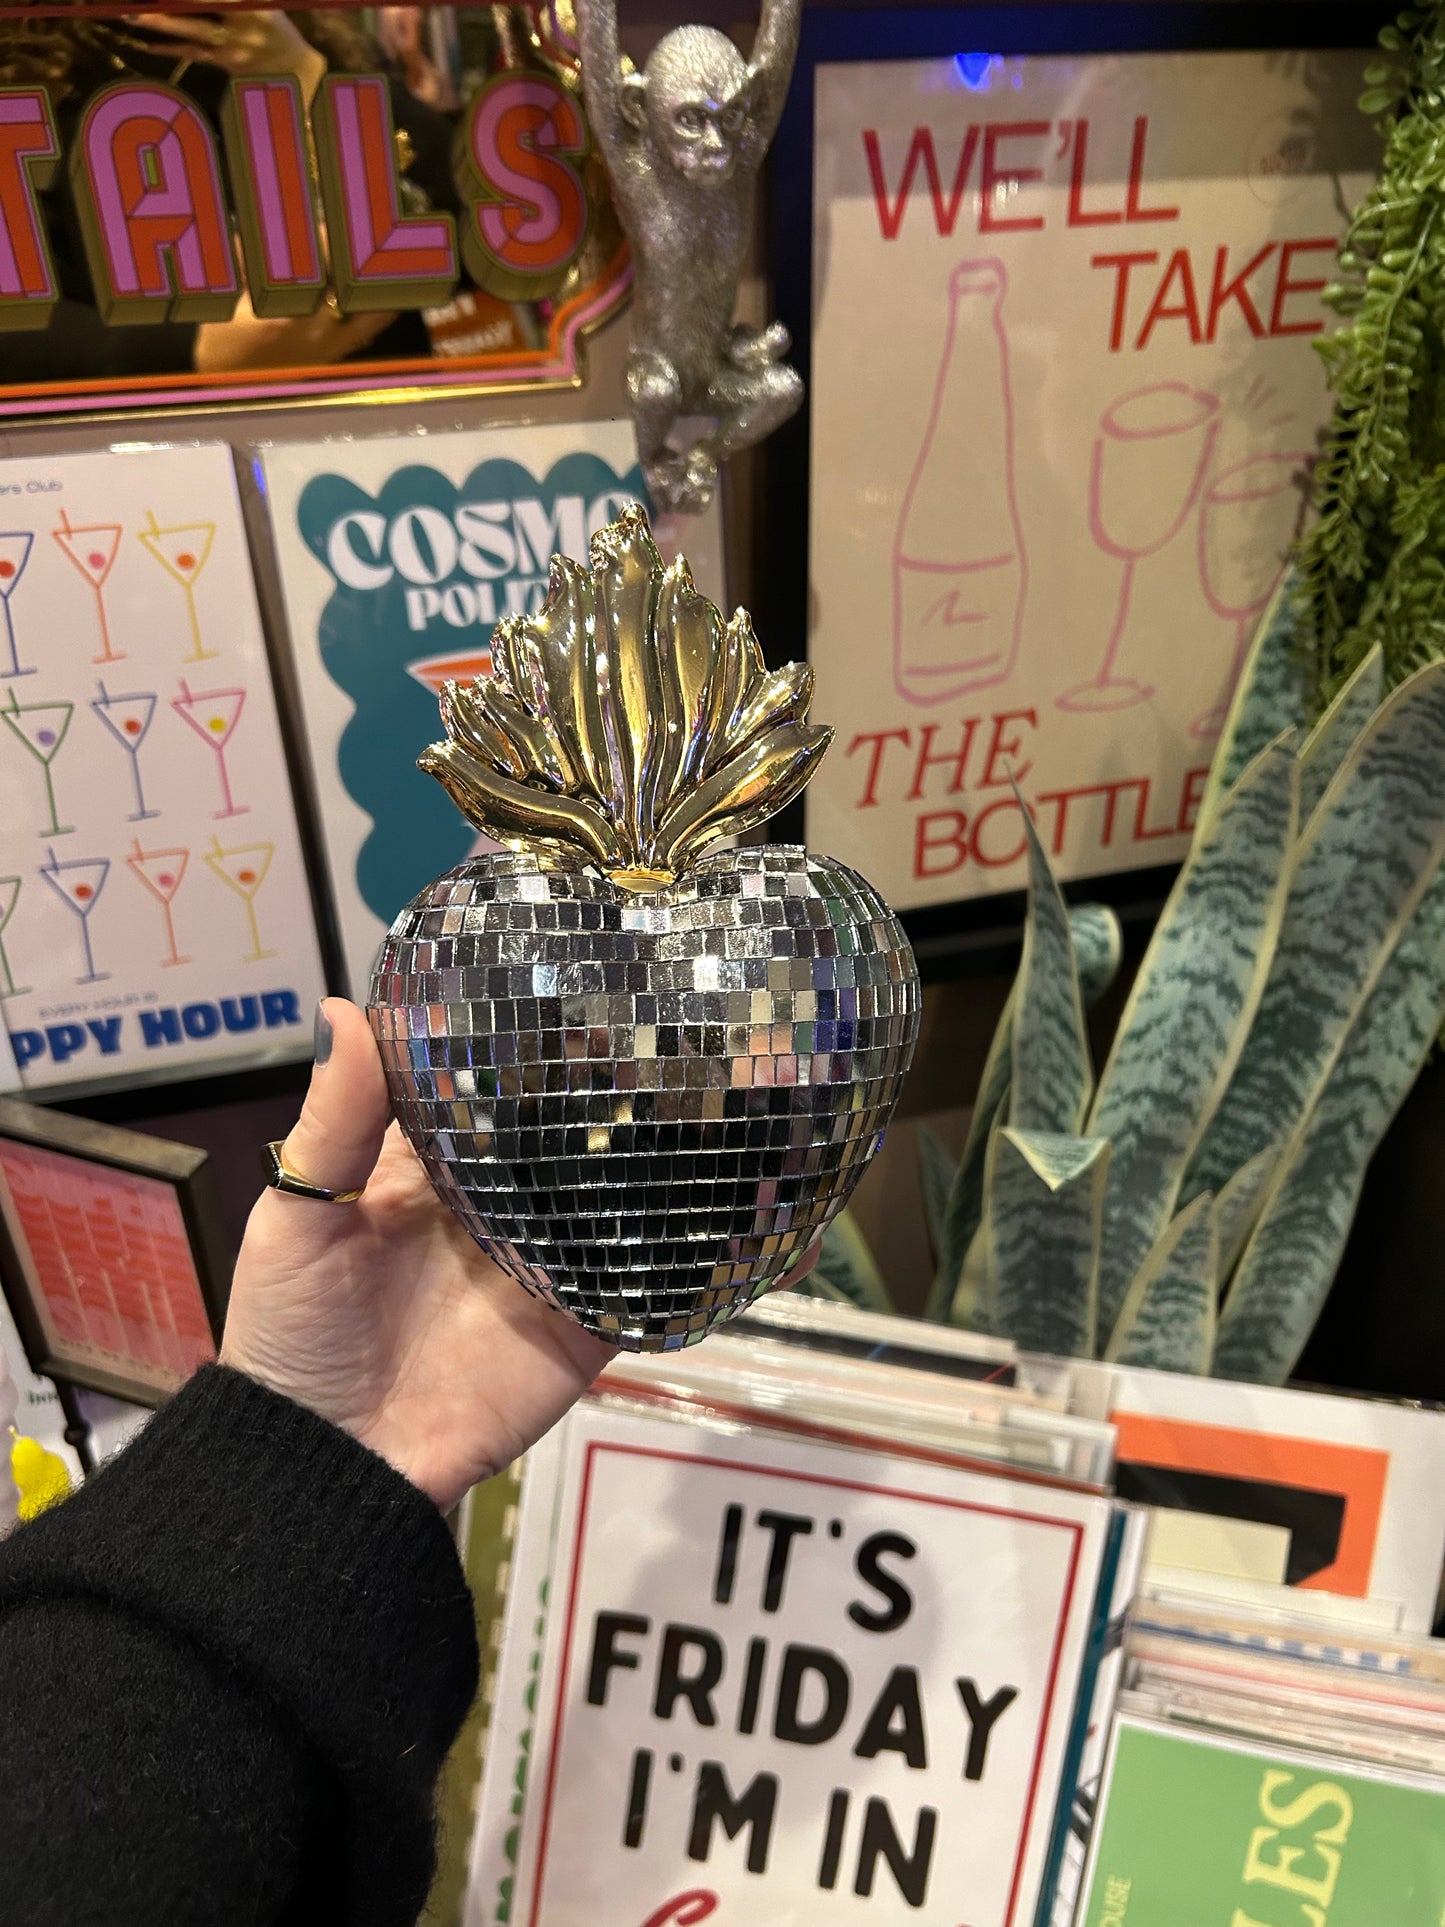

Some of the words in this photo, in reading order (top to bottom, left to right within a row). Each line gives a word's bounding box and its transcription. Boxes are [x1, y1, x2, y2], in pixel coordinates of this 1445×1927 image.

[862, 116, 1179, 241] WE'LL
[1092, 238, 1338, 353] TAKE
[26, 480, 63, 494] Club
[845, 706, 1039, 809] THE
[913, 766, 1211, 880] BOTTLE
[139, 988, 303, 1049] HOUR
[713, 1504, 917, 1634] IT'S
[586, 1611, 1018, 1781] FRIDAY
[623, 1748, 779, 1874] I'M
[818, 1787, 938, 1909] IN
